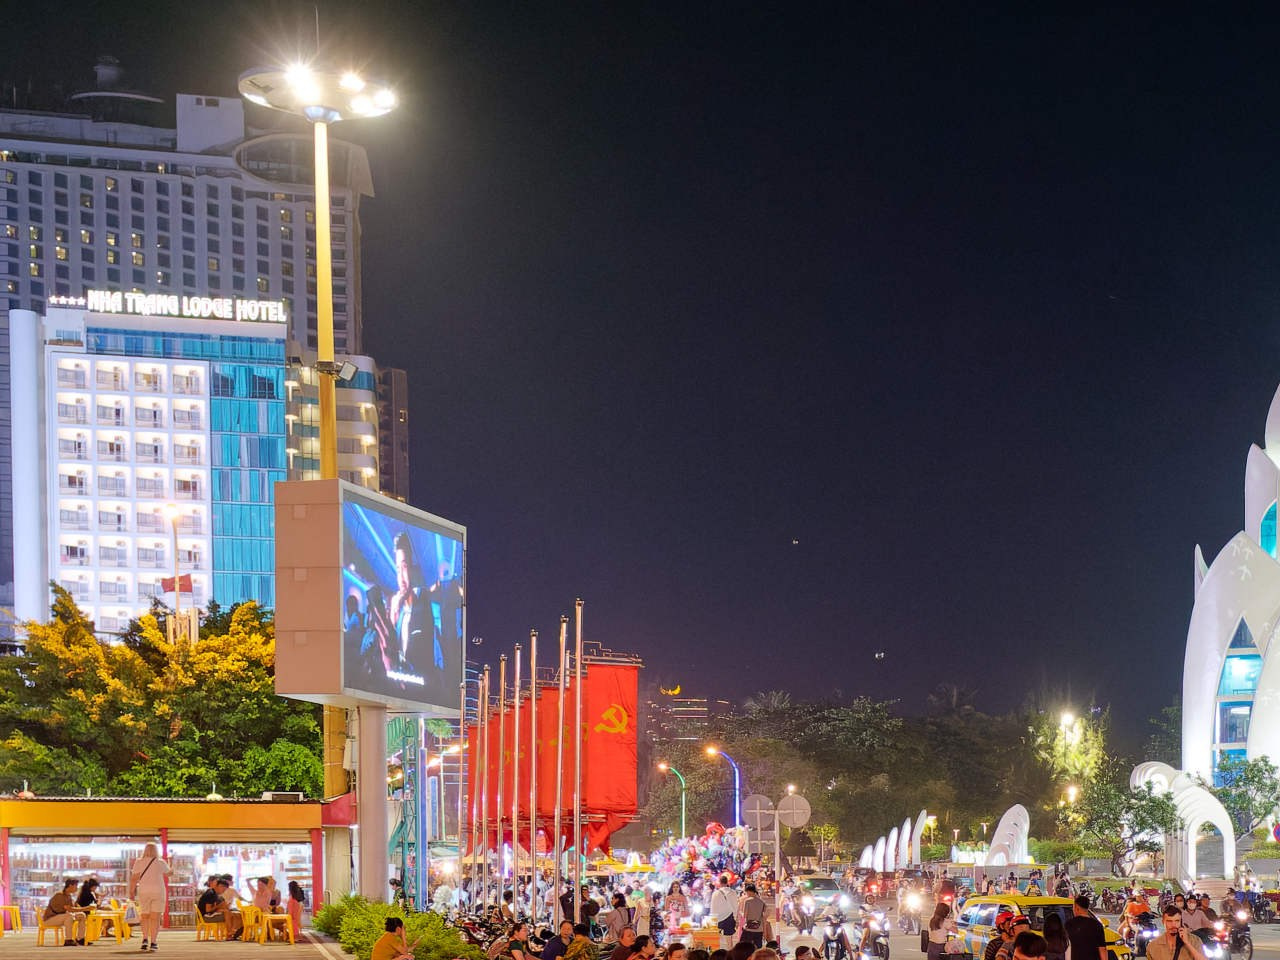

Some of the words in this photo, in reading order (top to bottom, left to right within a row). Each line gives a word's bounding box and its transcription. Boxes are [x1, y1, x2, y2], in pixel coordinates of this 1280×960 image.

[87, 290, 122, 313] NHA
[125, 293, 179, 316] TRANG
[182, 296, 233, 319] LODGE
[236, 299, 287, 322] HOTEL
